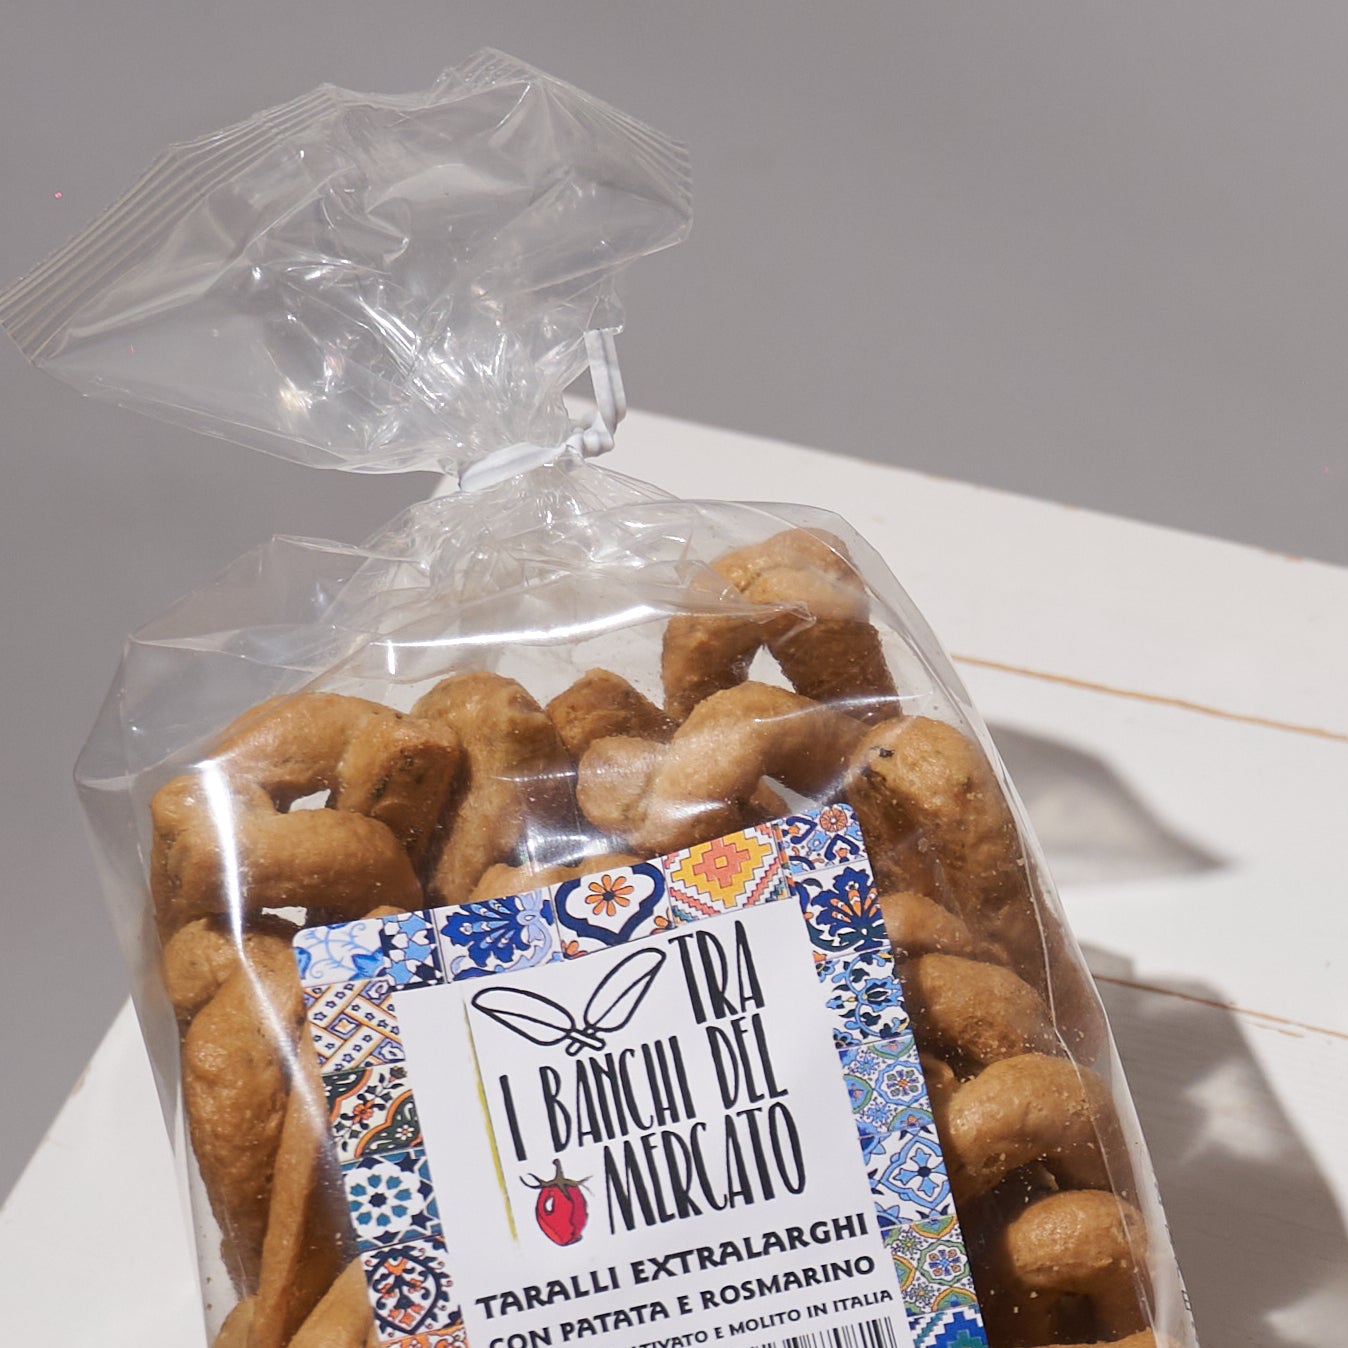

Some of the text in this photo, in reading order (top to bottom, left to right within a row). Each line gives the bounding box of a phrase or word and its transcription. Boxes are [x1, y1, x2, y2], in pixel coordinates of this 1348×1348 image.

[667, 919, 765, 1025] TRA
[498, 1012, 789, 1162] I BANCHI DEL
[603, 1101, 806, 1235] MERCATO
[475, 1212, 869, 1320] TARALLI EXTRALARGHI
[559, 1301, 670, 1342] PATATA
[676, 1294, 693, 1316] E
[699, 1255, 875, 1310] ROSMARINO
[713, 1326, 725, 1340] E
[728, 1309, 802, 1337] MOLITO
[806, 1302, 828, 1319] IN
[832, 1289, 893, 1313] ITALIA
